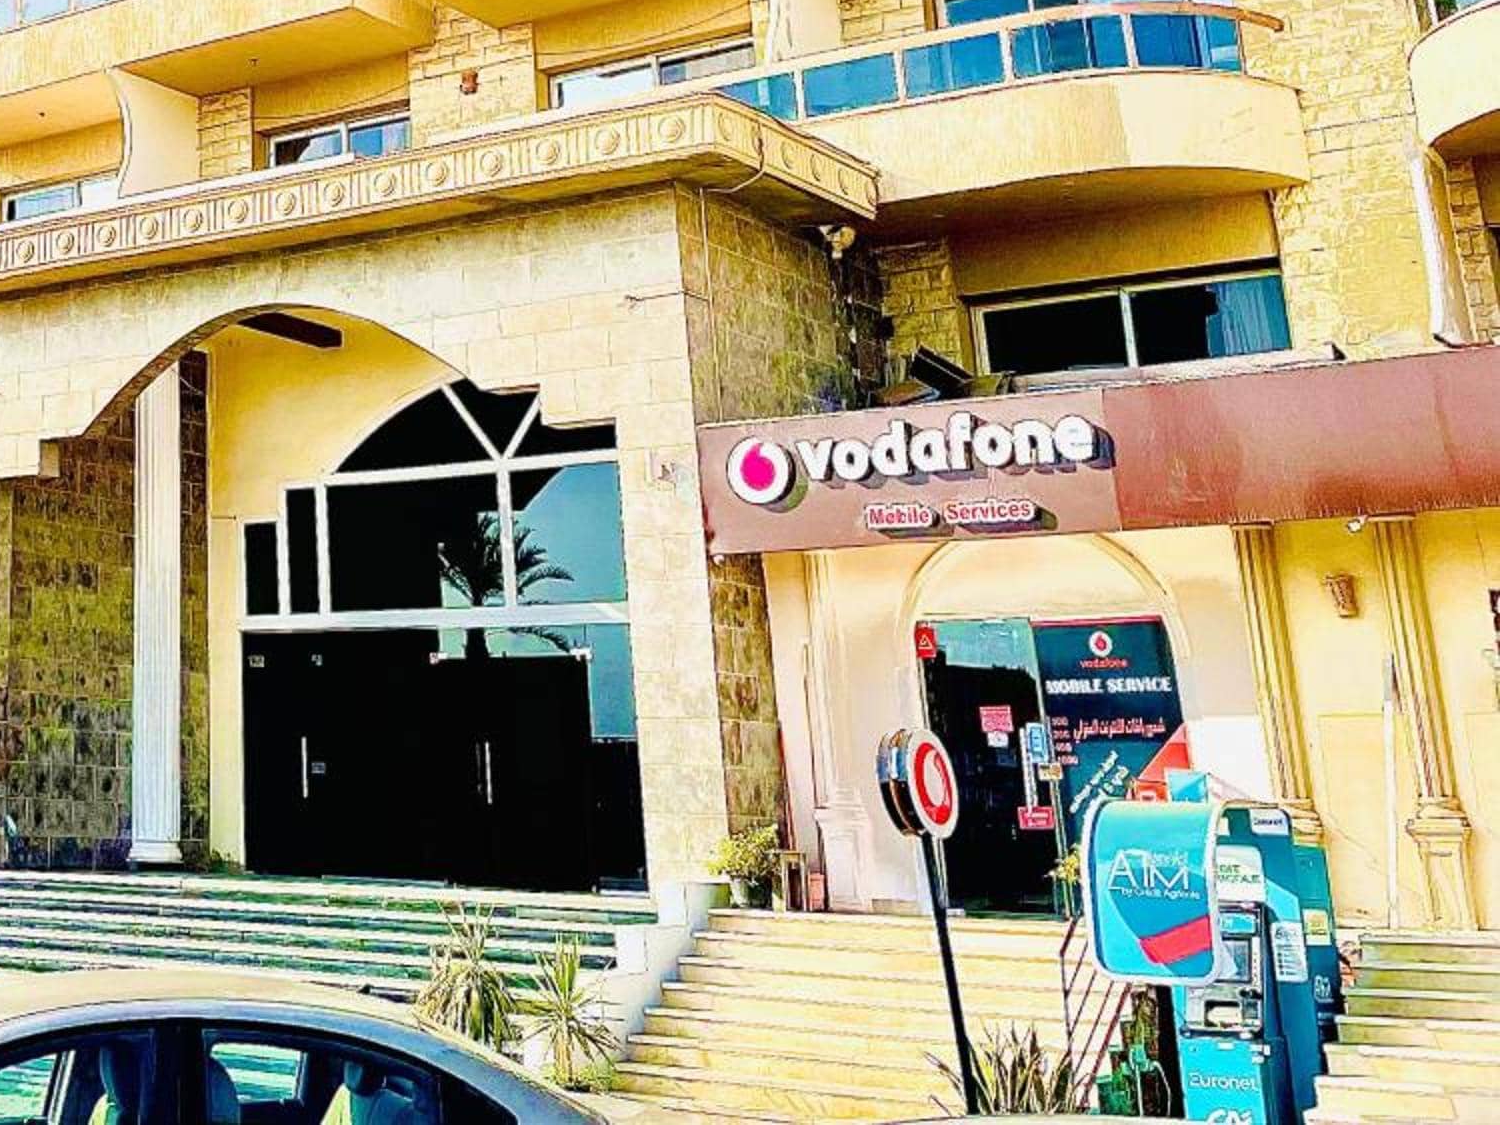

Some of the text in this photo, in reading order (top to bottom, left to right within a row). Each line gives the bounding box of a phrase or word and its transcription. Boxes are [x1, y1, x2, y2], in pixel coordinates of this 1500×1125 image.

[796, 411, 1096, 481] vodafone
[866, 500, 1035, 529] Mobile Services
[1045, 676, 1172, 694] MOBILE SERVICE
[1108, 849, 1189, 890] ATM
[1188, 1072, 1259, 1091] Euronet
